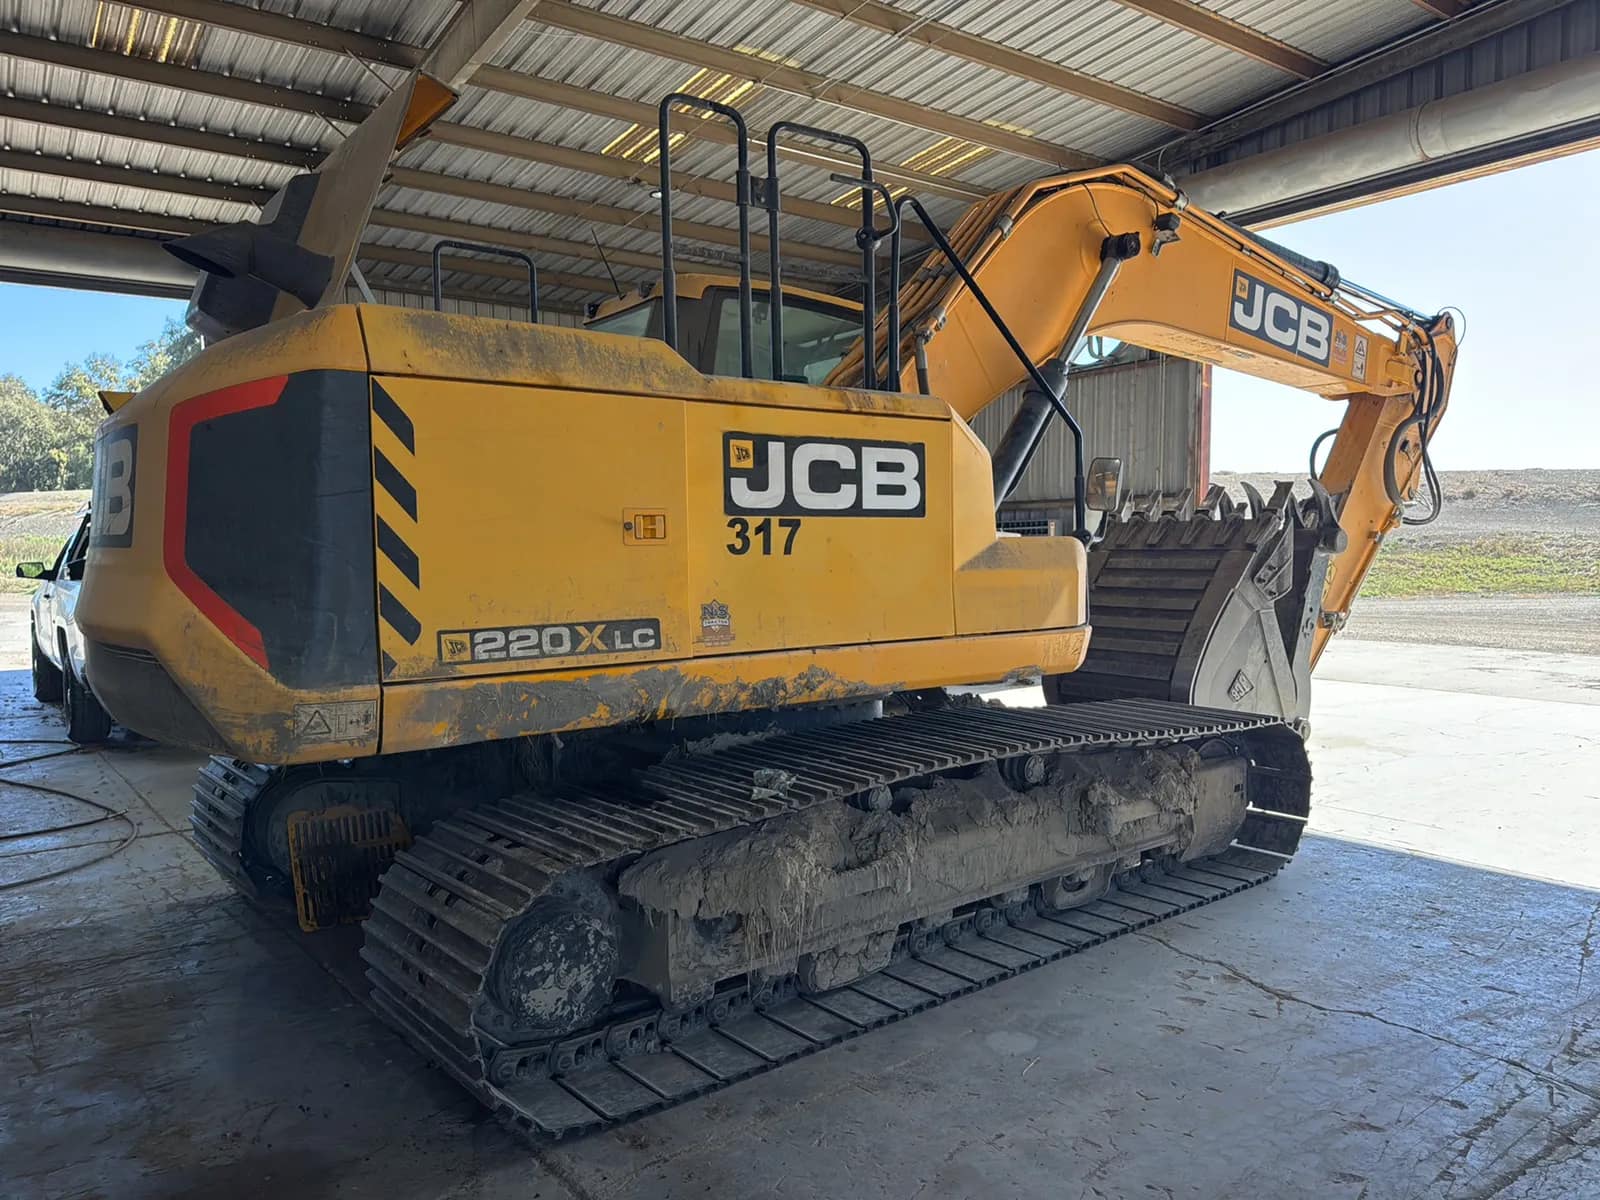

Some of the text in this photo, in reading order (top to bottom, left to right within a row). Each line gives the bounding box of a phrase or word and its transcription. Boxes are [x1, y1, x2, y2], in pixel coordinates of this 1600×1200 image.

[1234, 284, 1329, 360] JCB
[730, 441, 921, 510] JCB
[726, 517, 801, 555] 317
[447, 639, 466, 656] JCB
[615, 628, 655, 649] LC
